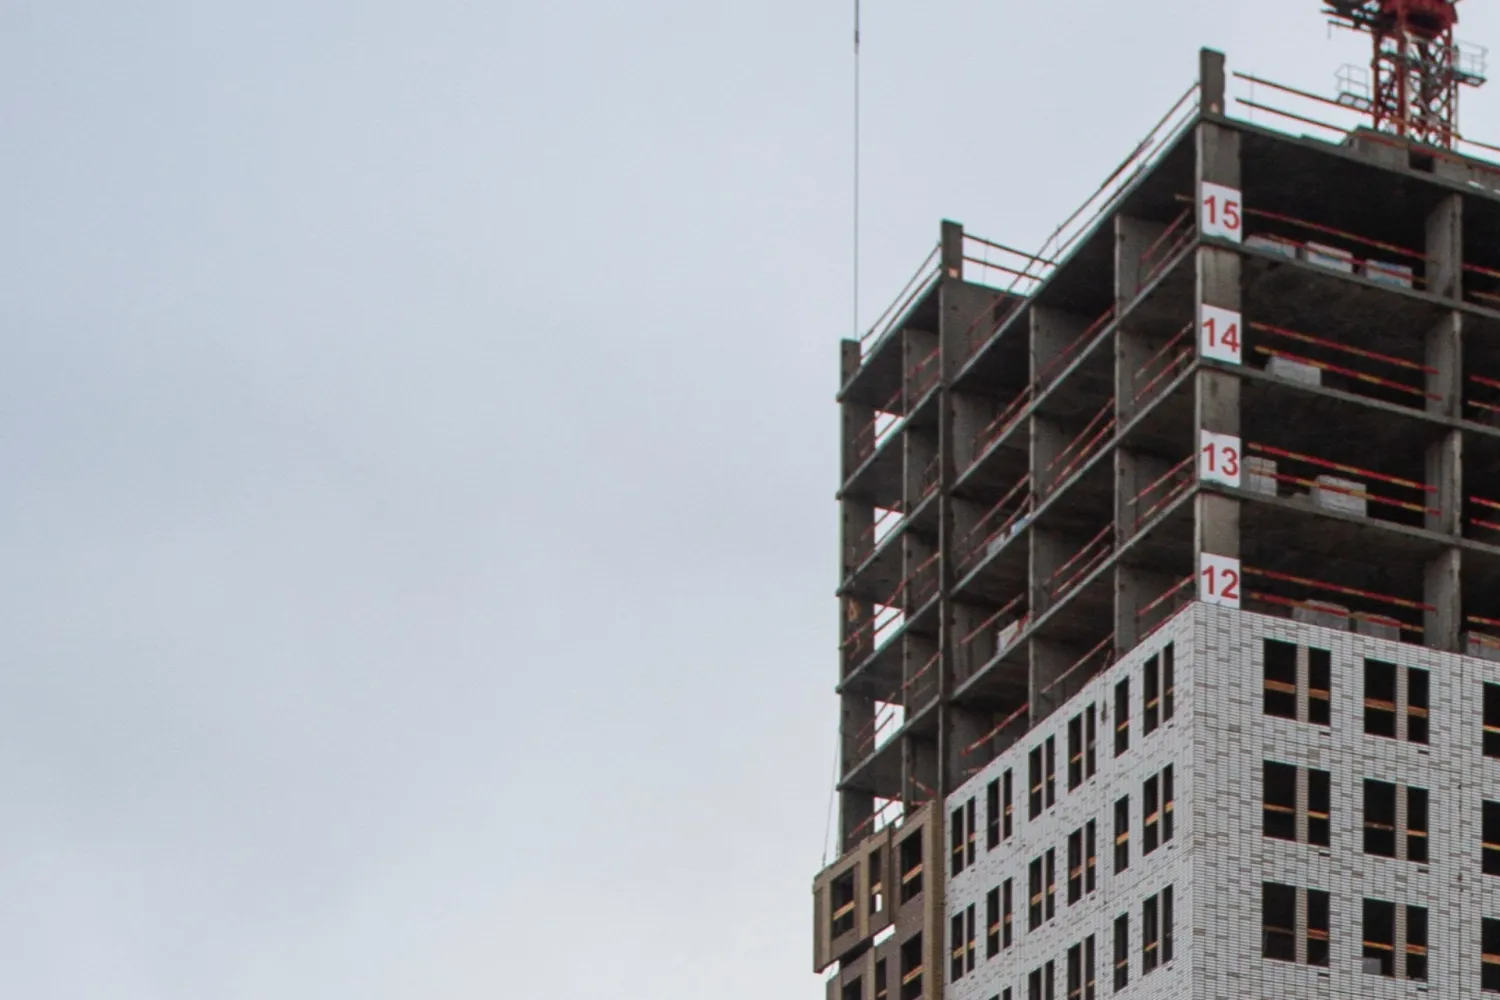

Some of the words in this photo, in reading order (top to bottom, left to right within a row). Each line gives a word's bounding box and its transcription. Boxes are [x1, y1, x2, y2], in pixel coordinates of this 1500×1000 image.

[1203, 195, 1241, 231] 15
[1202, 318, 1240, 353] 14
[1202, 443, 1240, 478] 13
[1201, 565, 1239, 601] 12
